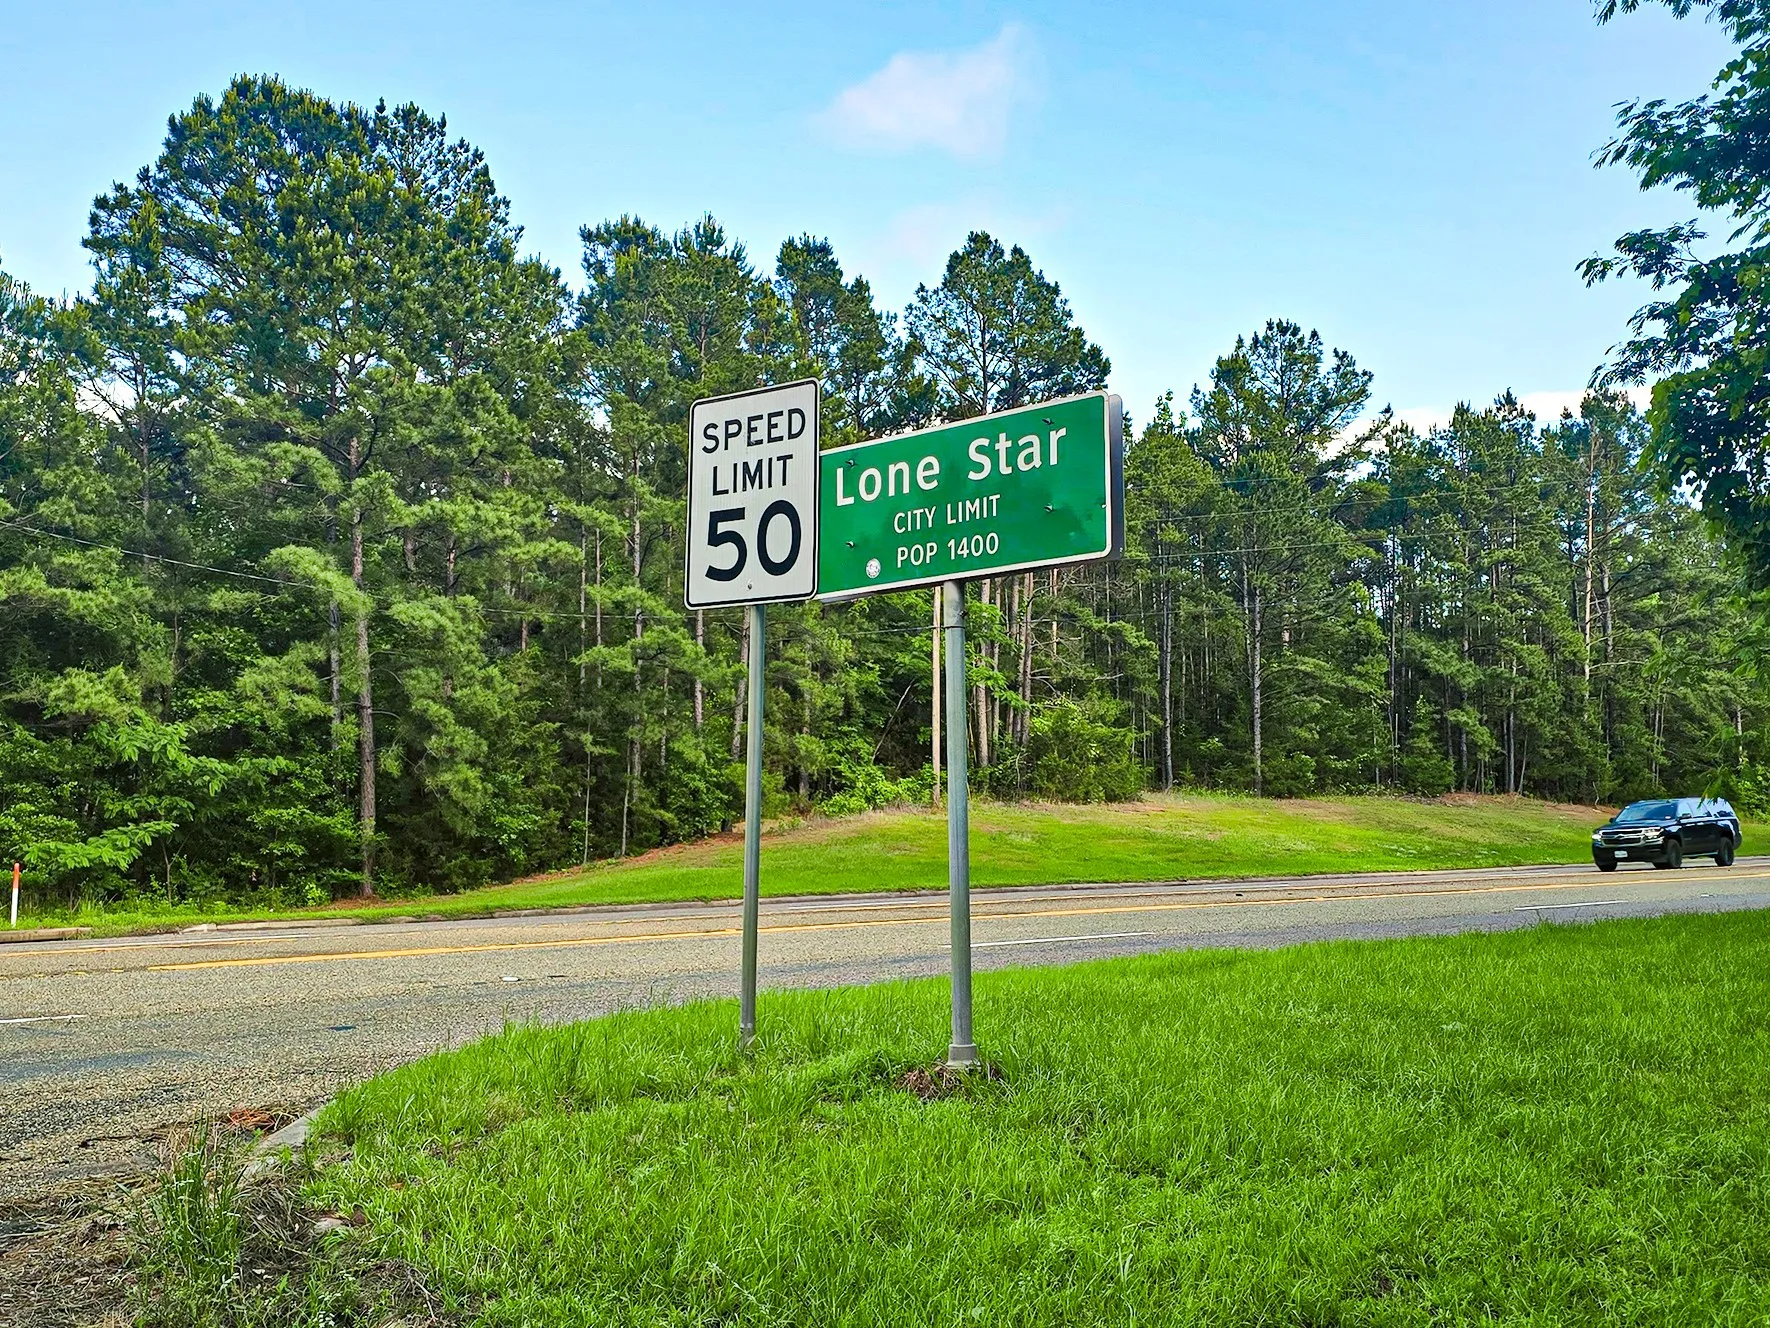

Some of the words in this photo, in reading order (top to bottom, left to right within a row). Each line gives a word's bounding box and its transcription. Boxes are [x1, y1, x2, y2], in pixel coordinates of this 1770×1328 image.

[701, 407, 807, 454] SPEED
[712, 454, 794, 496] LIMIT
[836, 455, 940, 507] Lone
[968, 426, 1068, 481] Star
[893, 505, 936, 534] CITY
[946, 494, 1002, 525] LIMIT
[705, 499, 802, 583] 50
[896, 541, 938, 569] POP
[947, 532, 1000, 561] 1400
